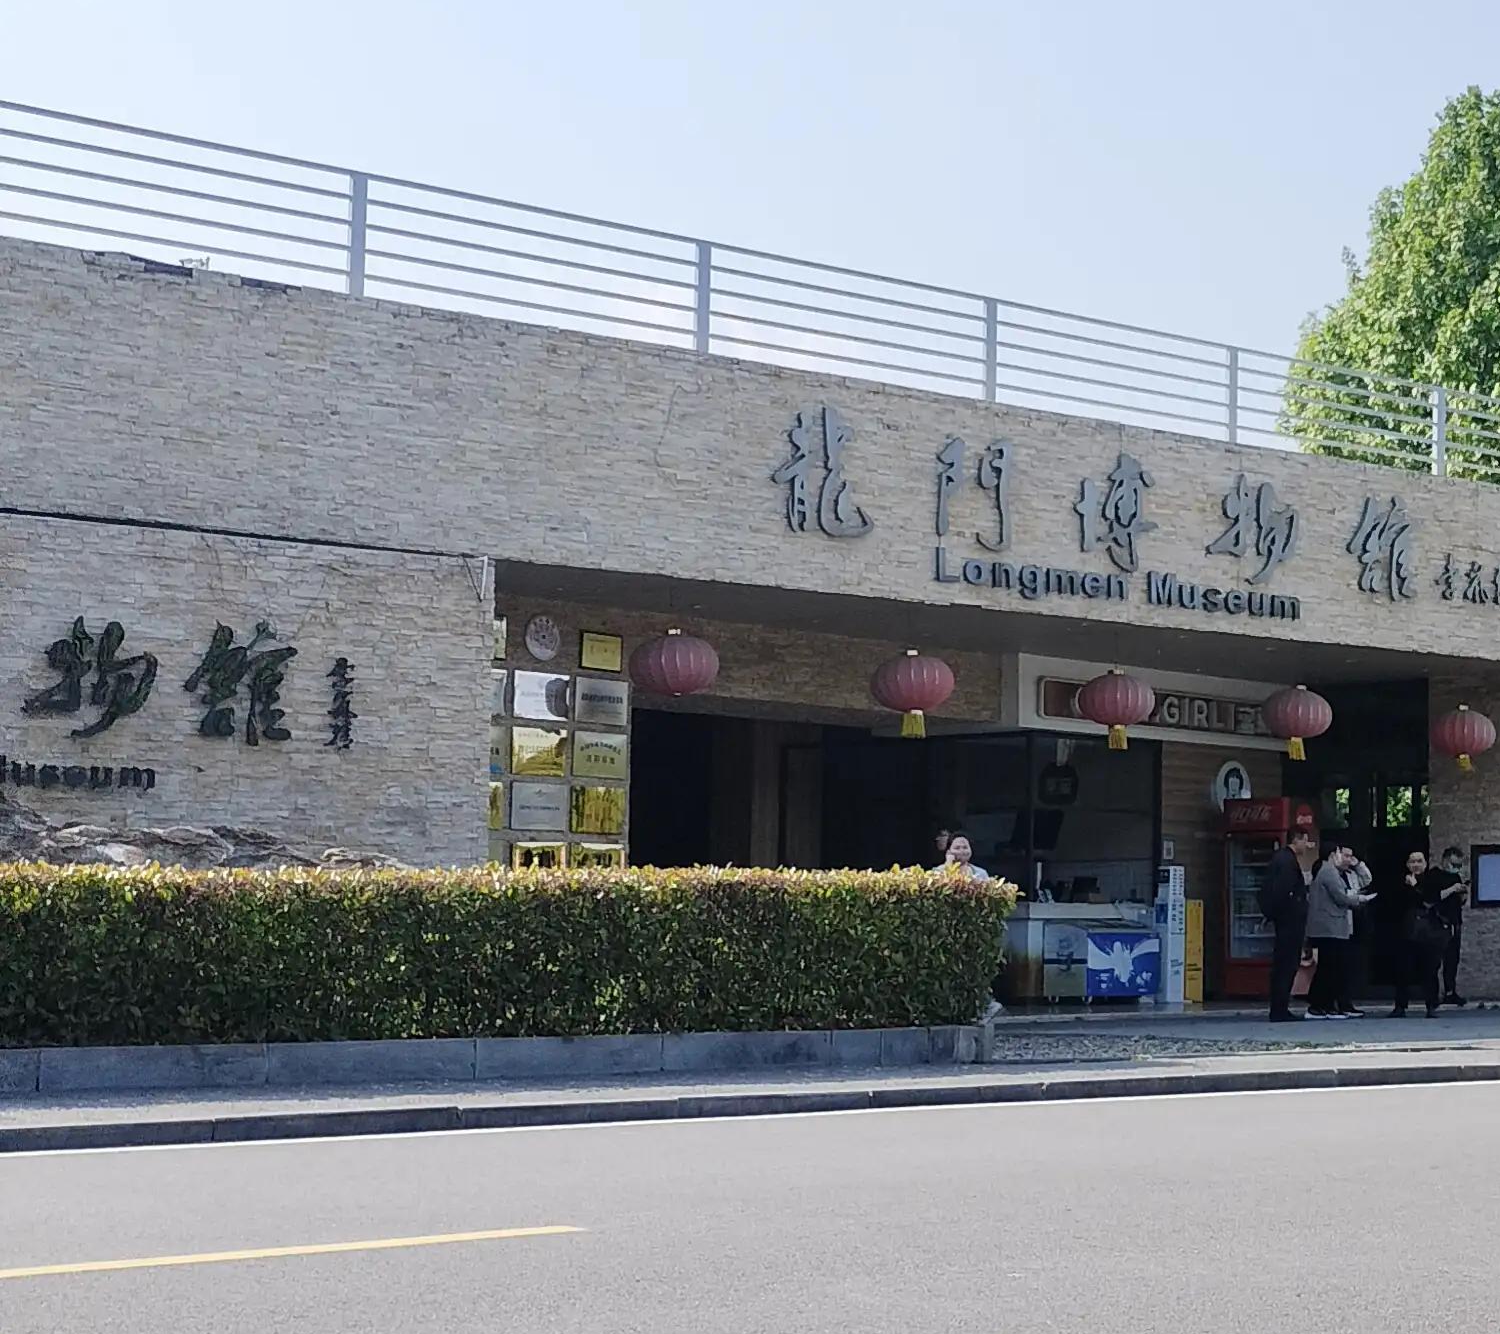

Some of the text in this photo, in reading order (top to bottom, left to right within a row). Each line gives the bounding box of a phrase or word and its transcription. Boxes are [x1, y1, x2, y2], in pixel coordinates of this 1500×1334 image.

[935, 546, 1301, 621] Longmen Museum
[0, 754, 156, 791] useum
